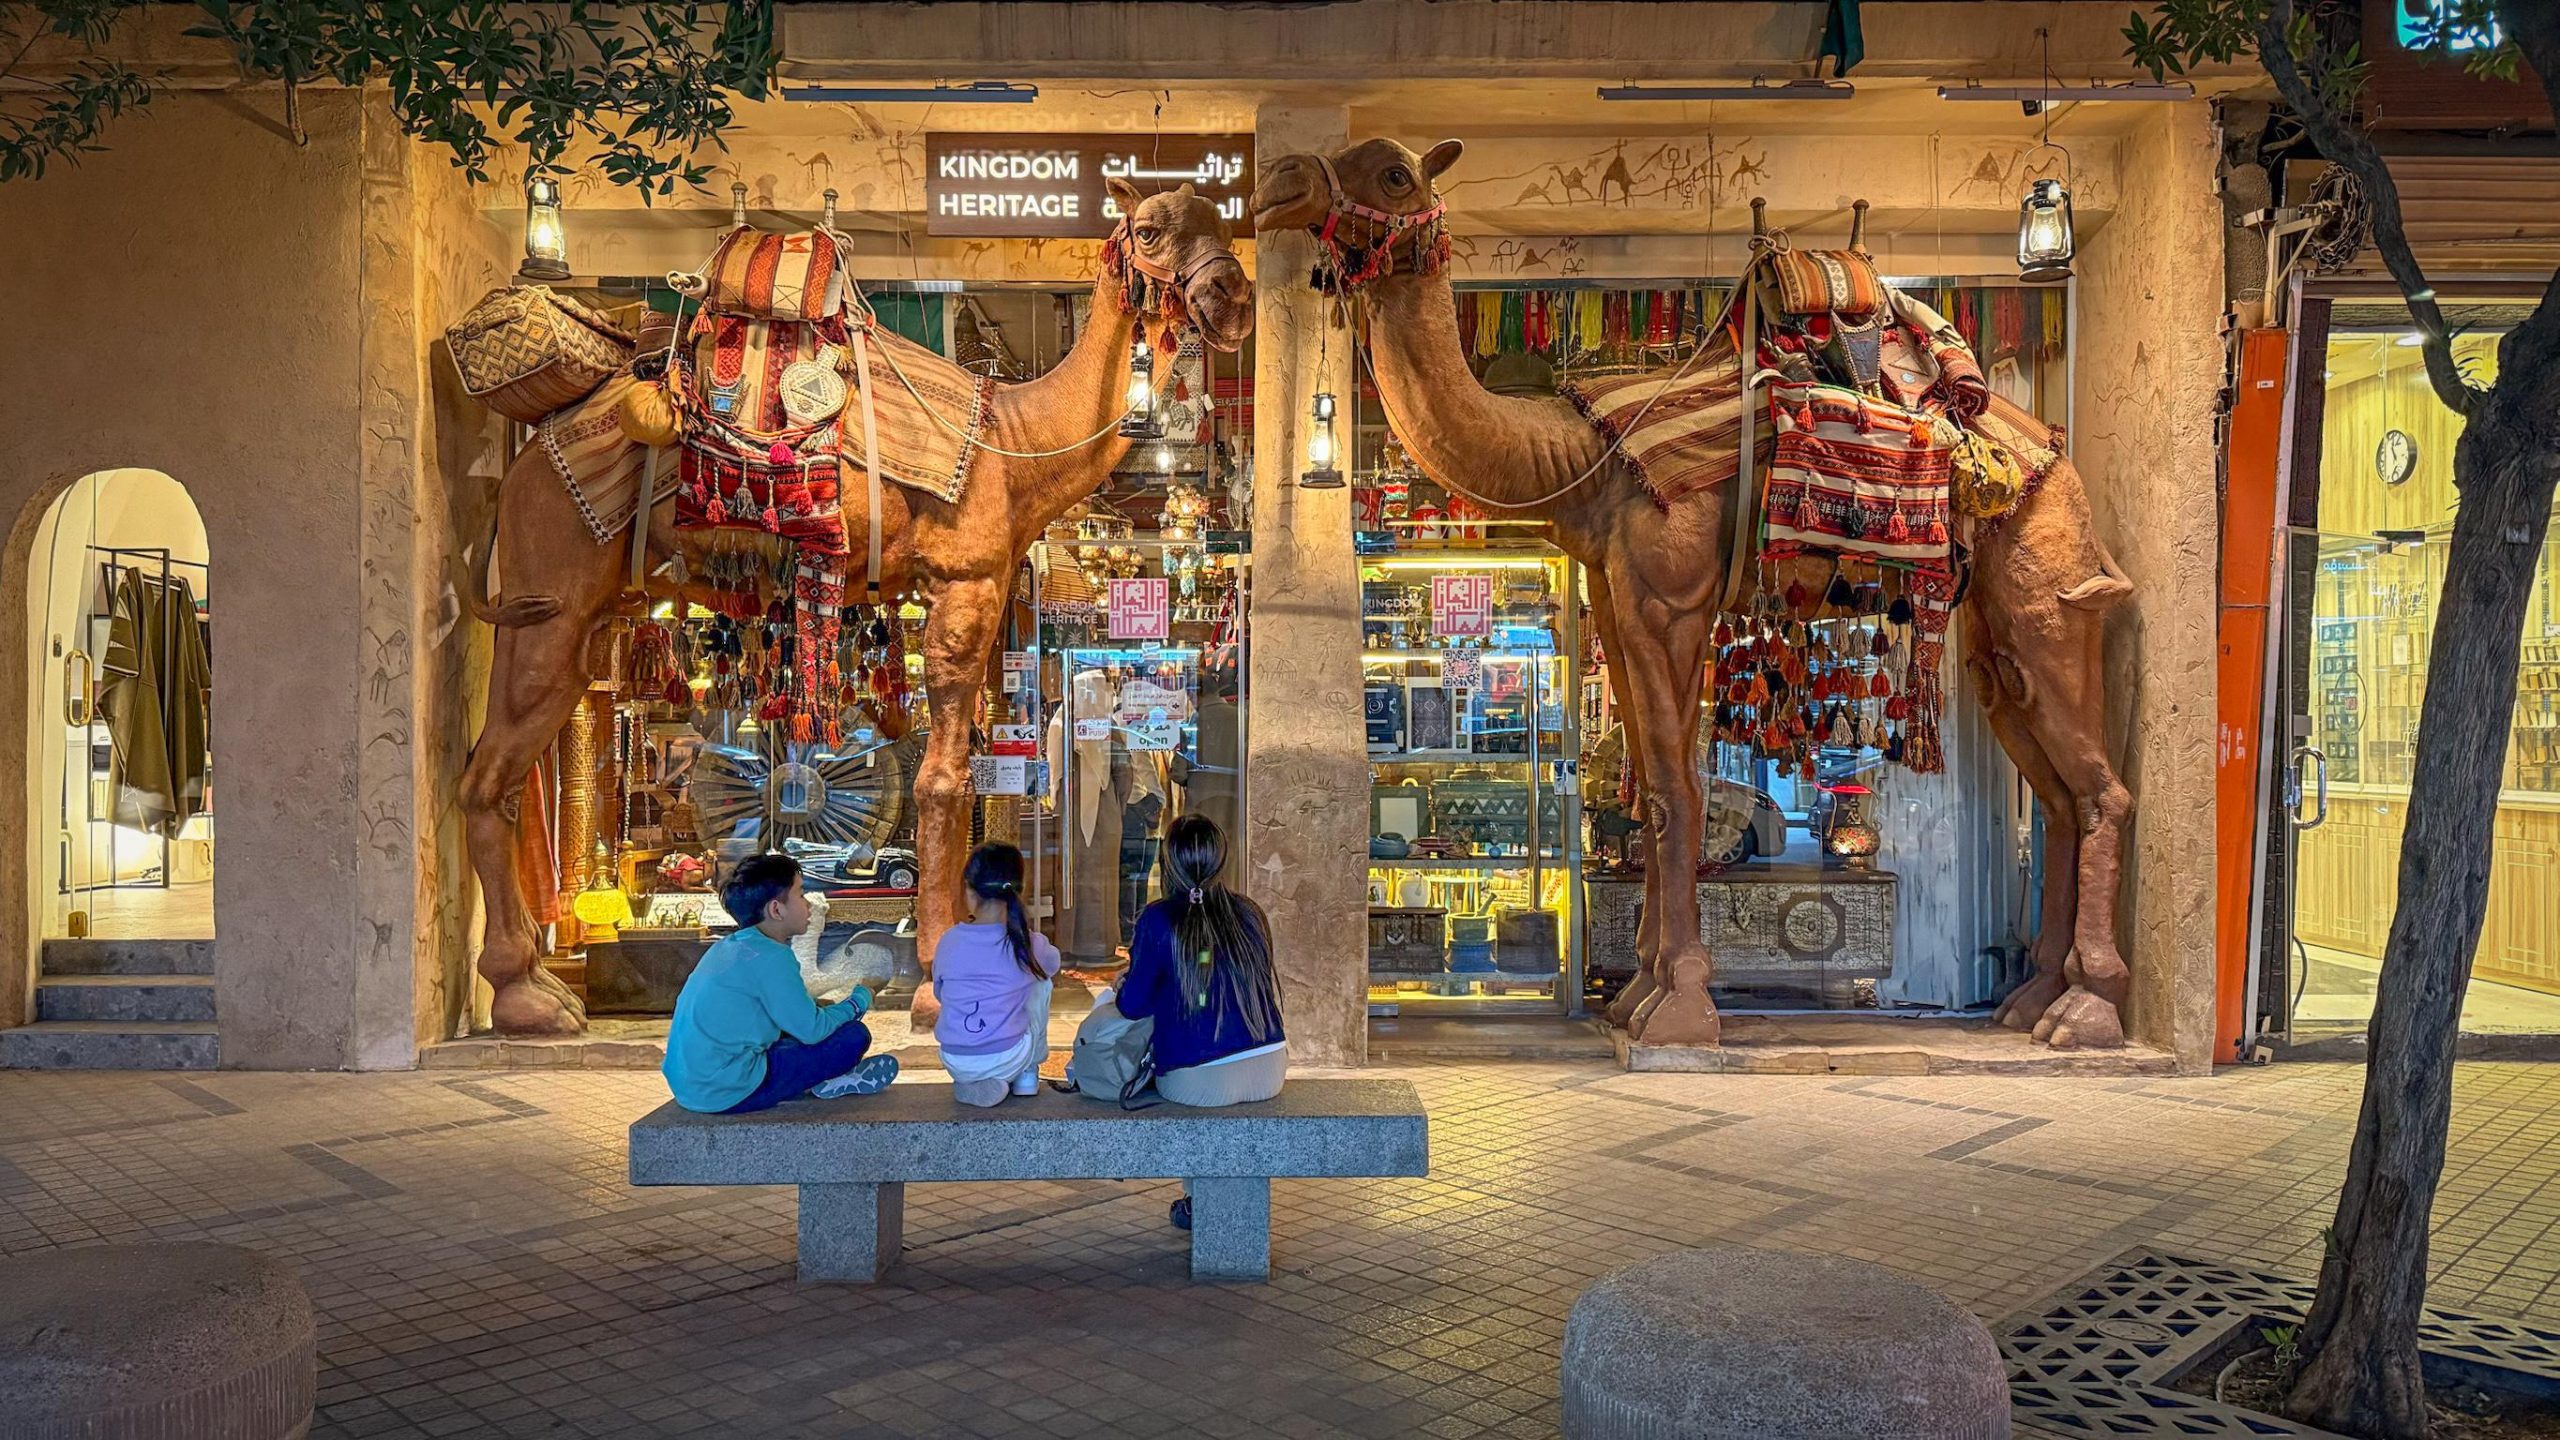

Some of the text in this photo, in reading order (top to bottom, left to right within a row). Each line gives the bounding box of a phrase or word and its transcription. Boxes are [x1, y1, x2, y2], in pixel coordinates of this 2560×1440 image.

[939, 156, 1079, 179] KINGDOM
[940, 194, 1080, 217] HERITAGE
[1040, 601, 1098, 611] KINGDOM
[1040, 614, 1099, 625] HERITAGE
[1139, 736, 1168, 746] open
